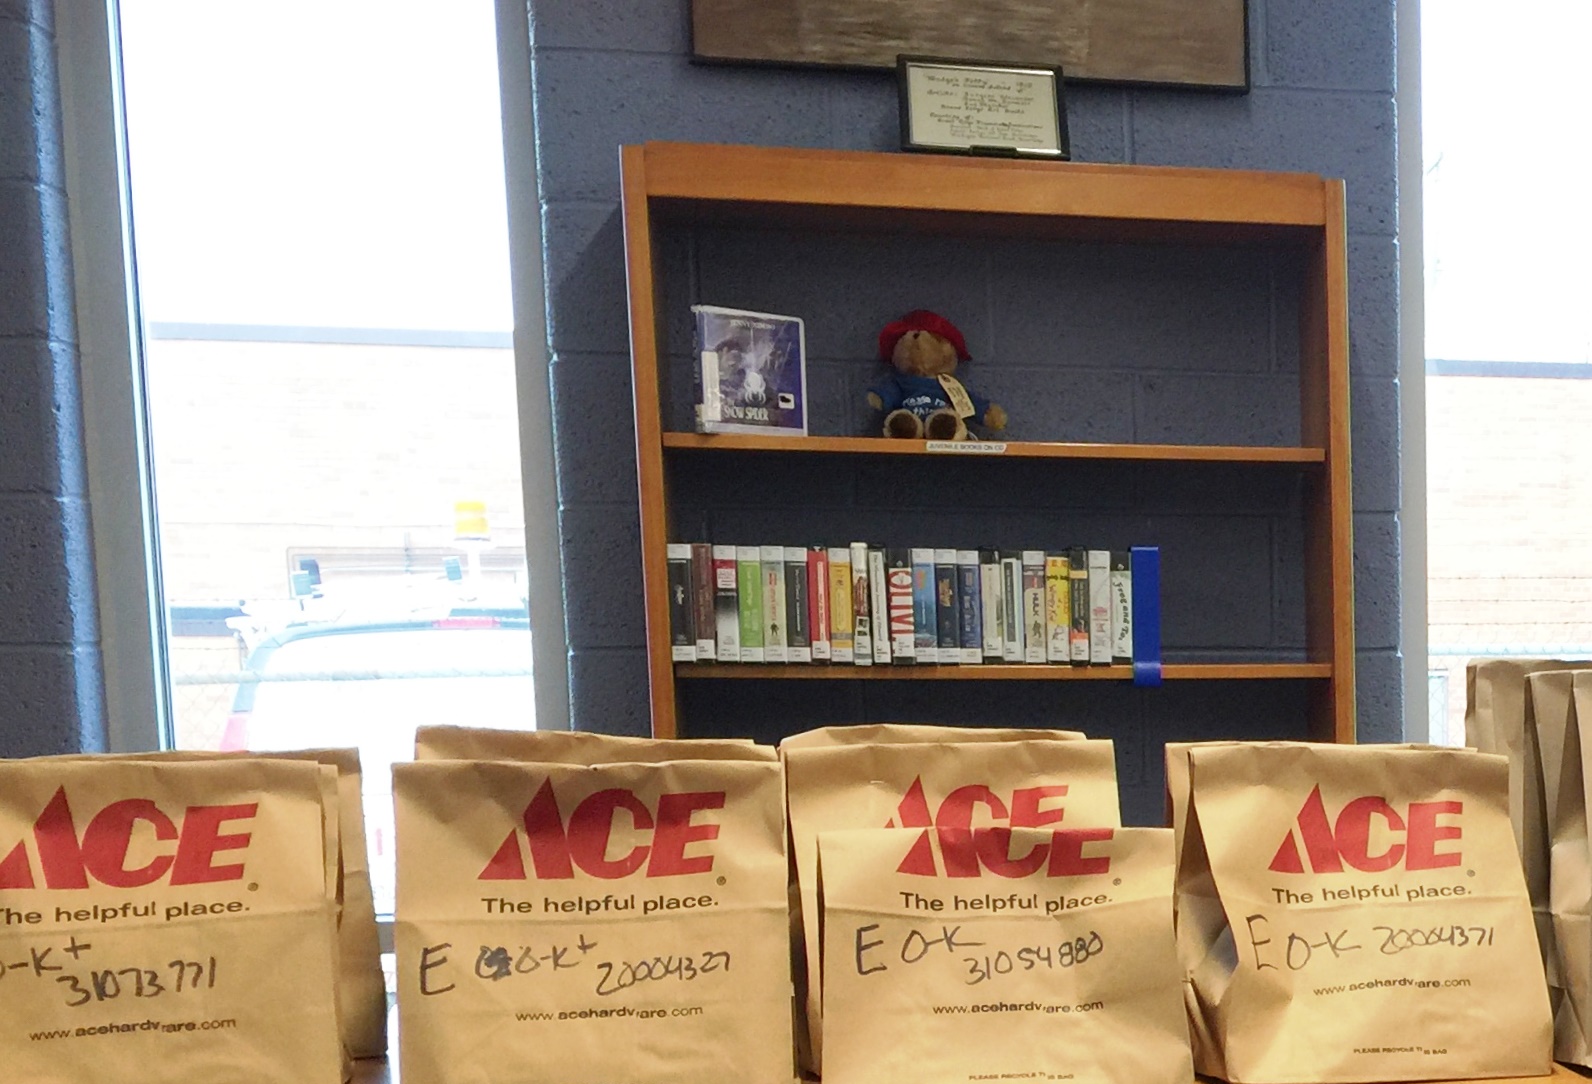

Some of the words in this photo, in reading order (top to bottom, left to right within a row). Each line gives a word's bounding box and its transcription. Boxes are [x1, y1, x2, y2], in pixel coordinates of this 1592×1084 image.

[477, 775, 725, 880] ACE
[1268, 782, 1463, 875] ACE
[55, 901, 156, 923] helpful
[165, 901, 250, 921] place.
[481, 898, 532, 914] The
[544, 894, 635, 914] helpful
[642, 894, 718, 915] place.
[899, 891, 945, 912] The
[953, 894, 1038, 913] helpful
[1045, 893, 1113, 913] place.
[1271, 887, 1313, 905] The
[1322, 884, 1400, 904] helpful
[1406, 884, 1472, 902] place.
[855, 924, 887, 976] E
[1246, 913, 1278, 971] E
[419, 942, 455, 995] E
